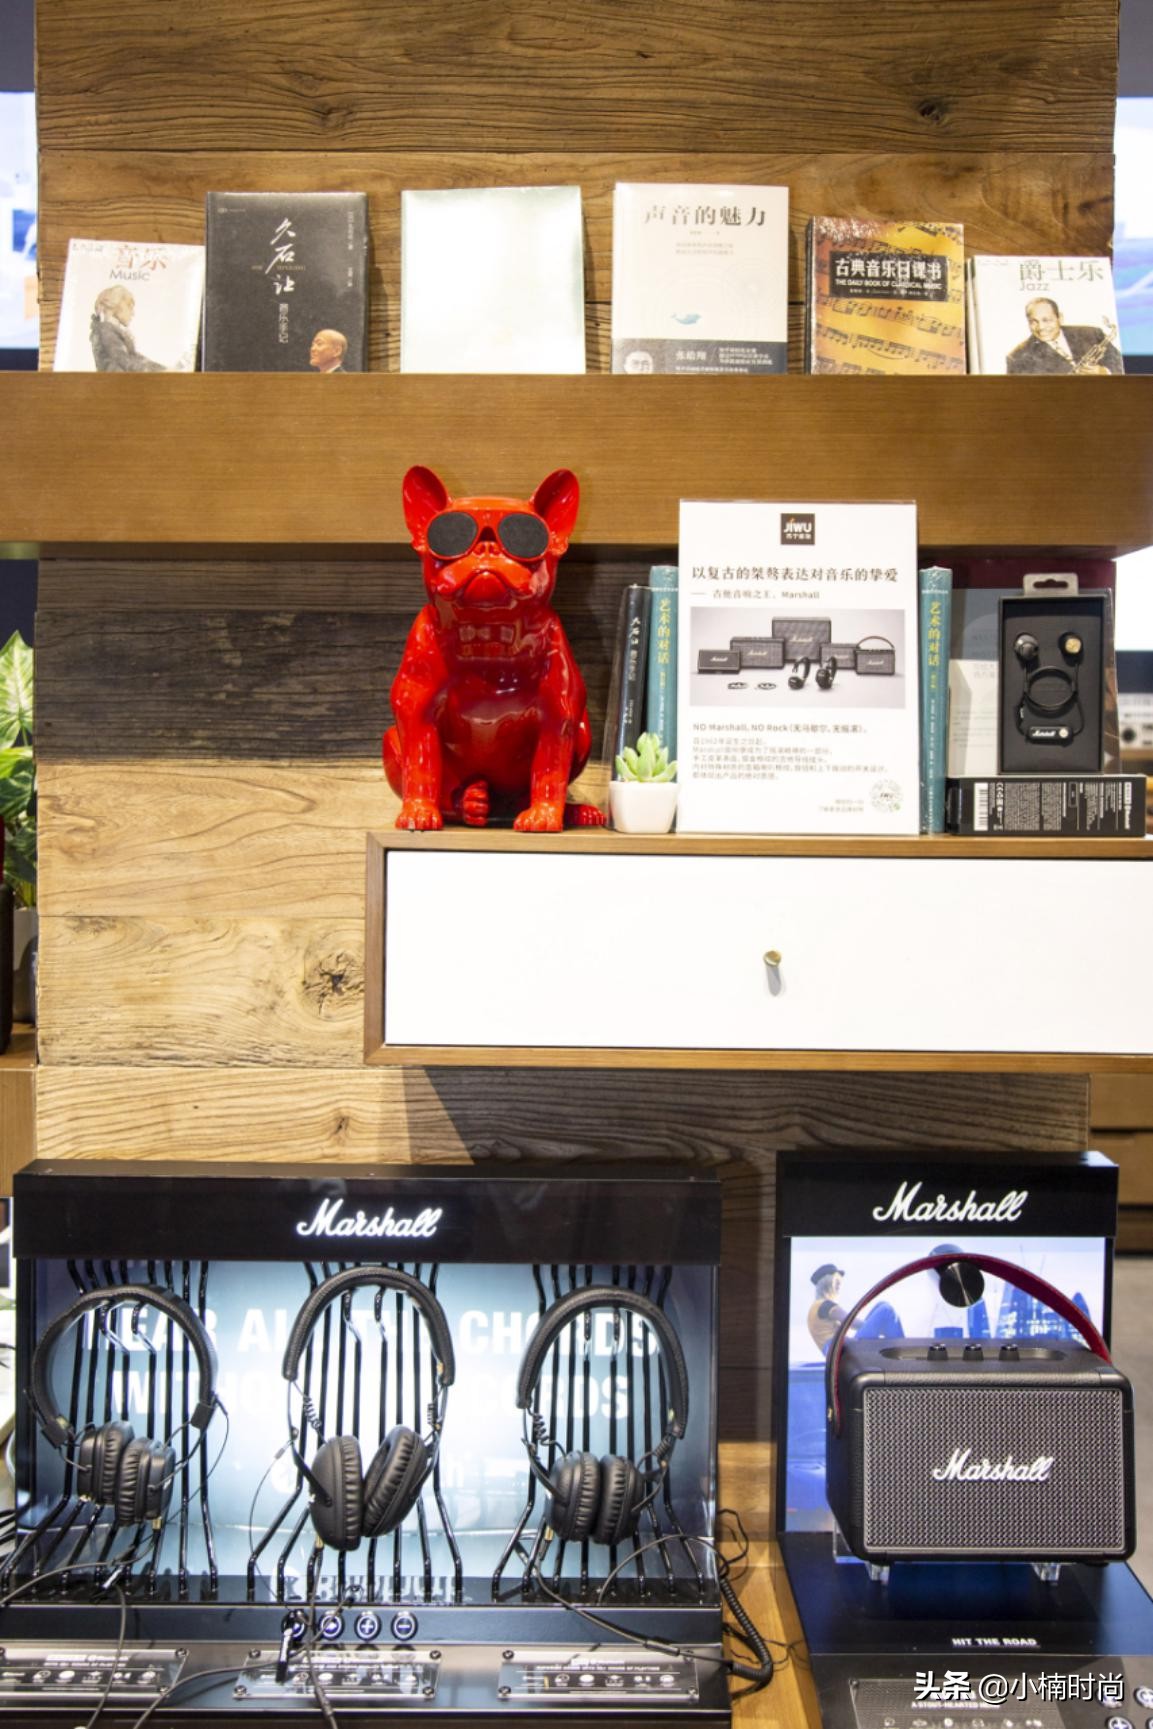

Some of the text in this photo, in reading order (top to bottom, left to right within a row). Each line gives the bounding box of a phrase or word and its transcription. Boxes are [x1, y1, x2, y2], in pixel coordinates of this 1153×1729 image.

[645, 205, 766, 227] 声音的魅力
[110, 269, 151, 281] Music
[1020, 258, 1104, 282] 爵士乐
[691, 565, 899, 583] 以复古的桀骜表达对音乐的挚爱
[782, 590, 820, 600] Marshall
[872, 1181, 1029, 1222] Marshall
[296, 1198, 443, 1237] Marshall
[933, 1448, 1054, 1482] Marshall
[952, 1637, 1037, 1647] HIT THE ROAD
